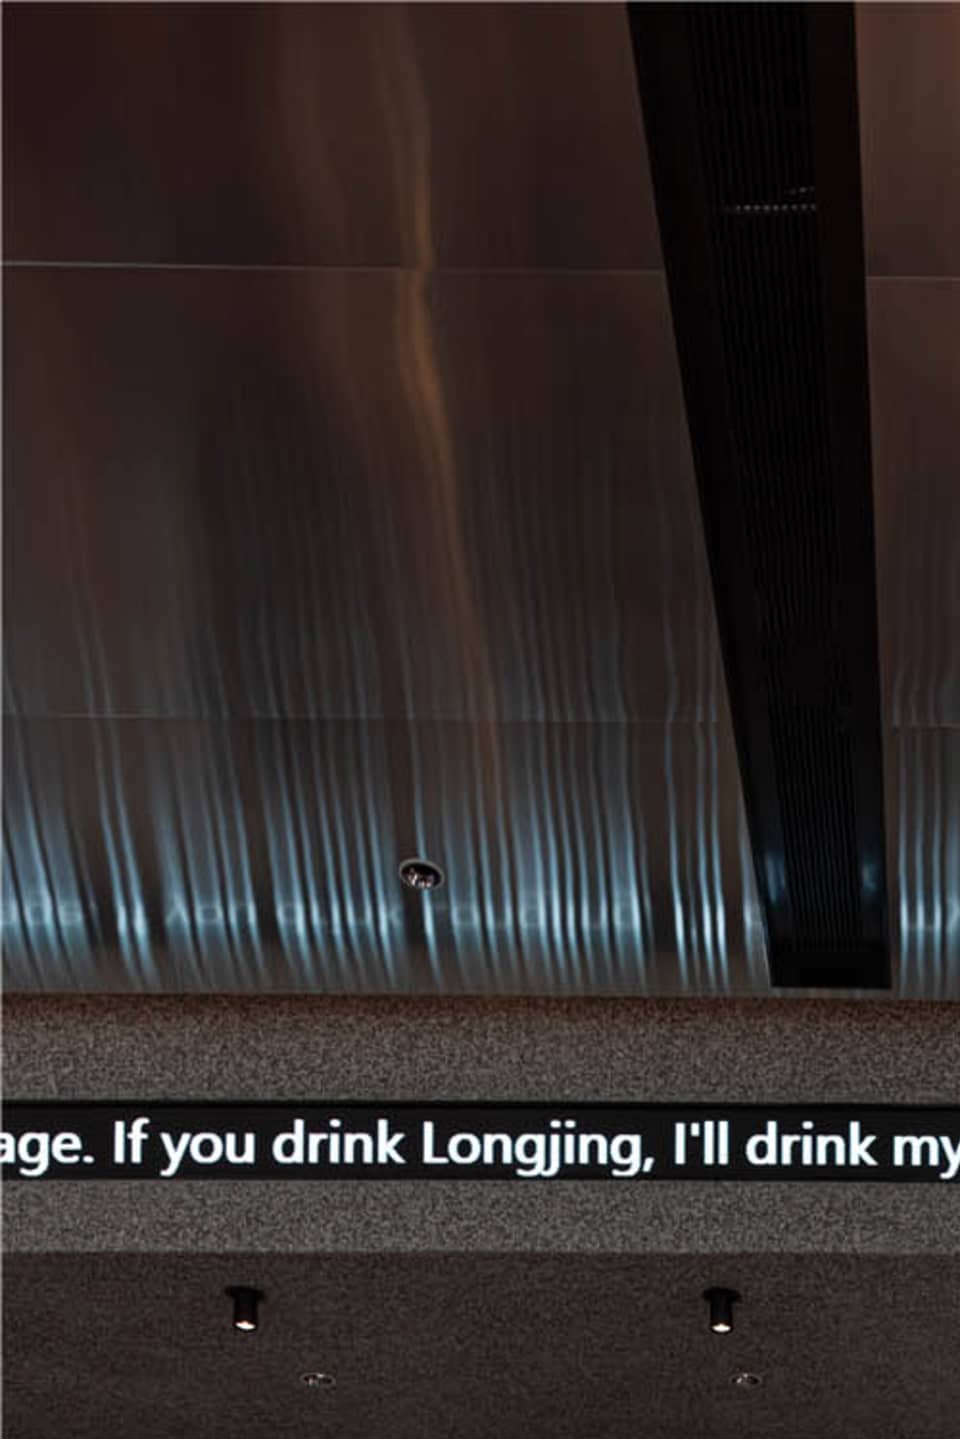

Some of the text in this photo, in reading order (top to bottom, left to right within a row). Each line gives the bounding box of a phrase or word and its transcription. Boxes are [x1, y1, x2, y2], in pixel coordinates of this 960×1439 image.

[0, 1132, 95, 1177] age.
[115, 1118, 150, 1164] If
[160, 1133, 254, 1177] you
[273, 1119, 405, 1164] drink
[423, 1120, 655, 1177] Longjing,
[675, 1120, 728, 1165] I'll
[746, 1121, 877, 1166] drink
